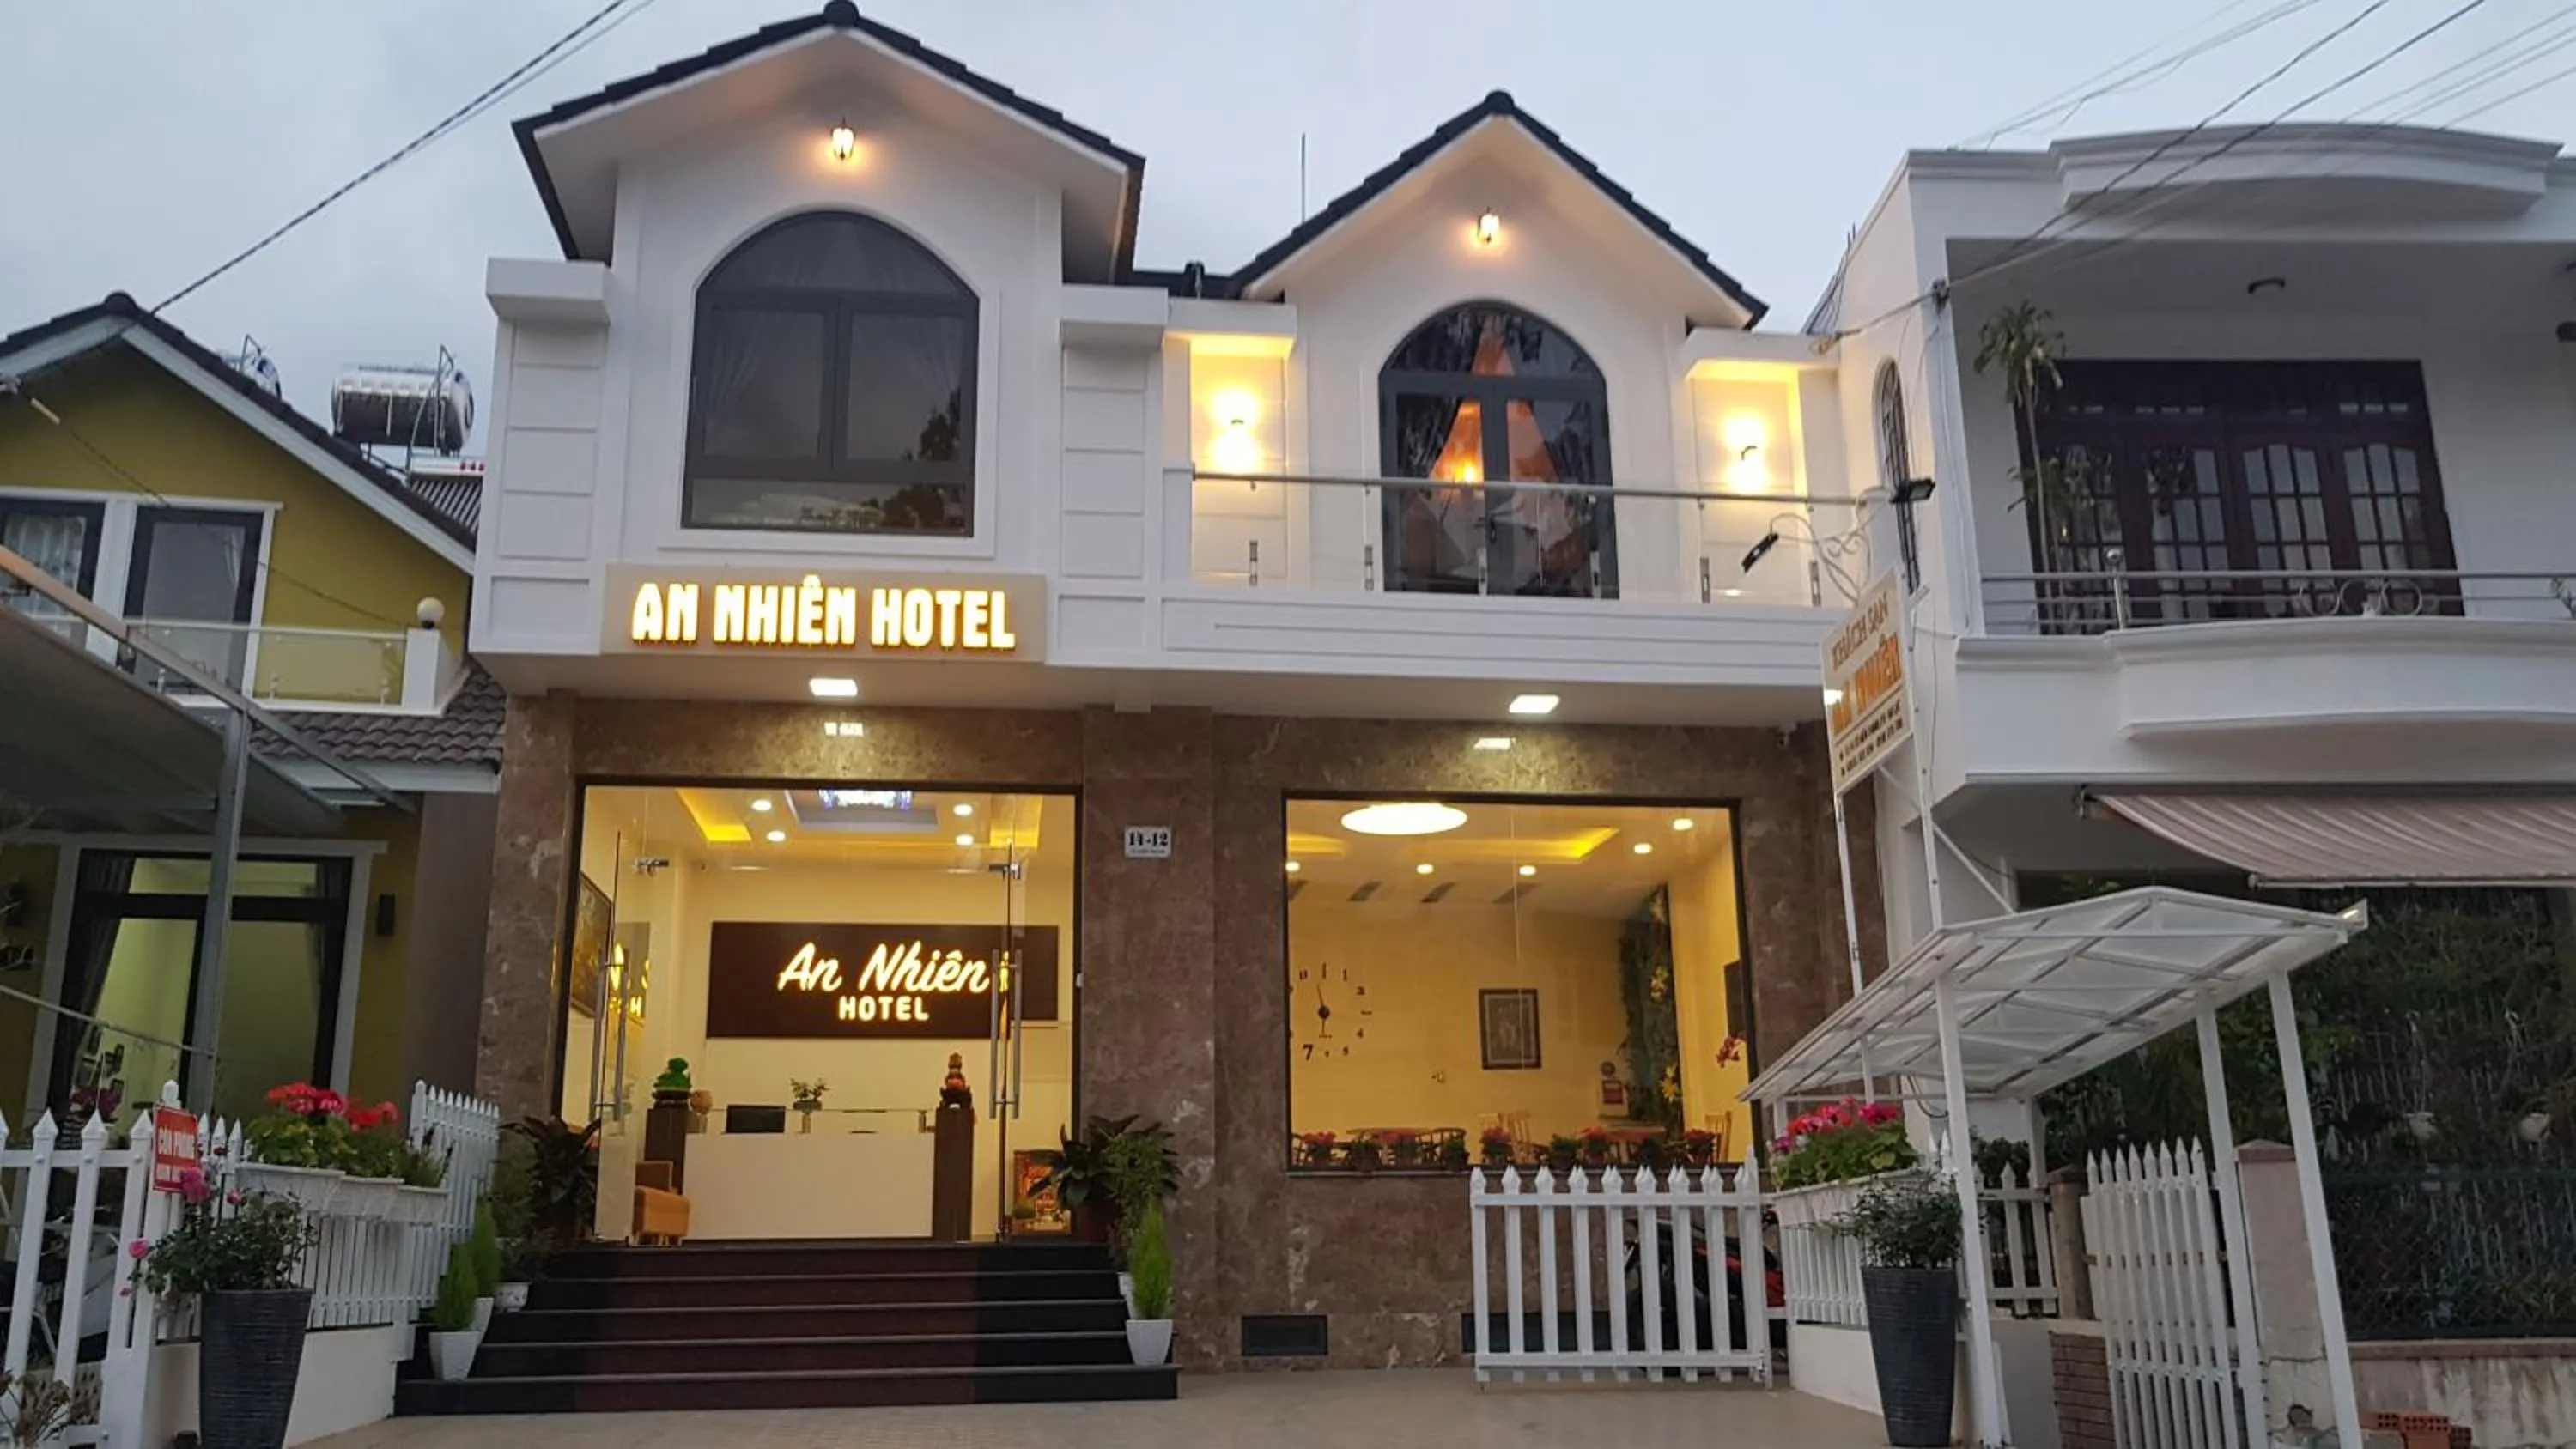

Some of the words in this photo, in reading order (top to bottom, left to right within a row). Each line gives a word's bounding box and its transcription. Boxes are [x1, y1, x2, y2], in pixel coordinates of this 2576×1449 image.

[631, 583, 700, 643] AN
[713, 574, 856, 646] NHIÊN
[870, 588, 1017, 650] HOTEL
[777, 941, 843, 991] An
[859, 940, 990, 993] Nhiên
[837, 995, 929, 1021] HOTEL
